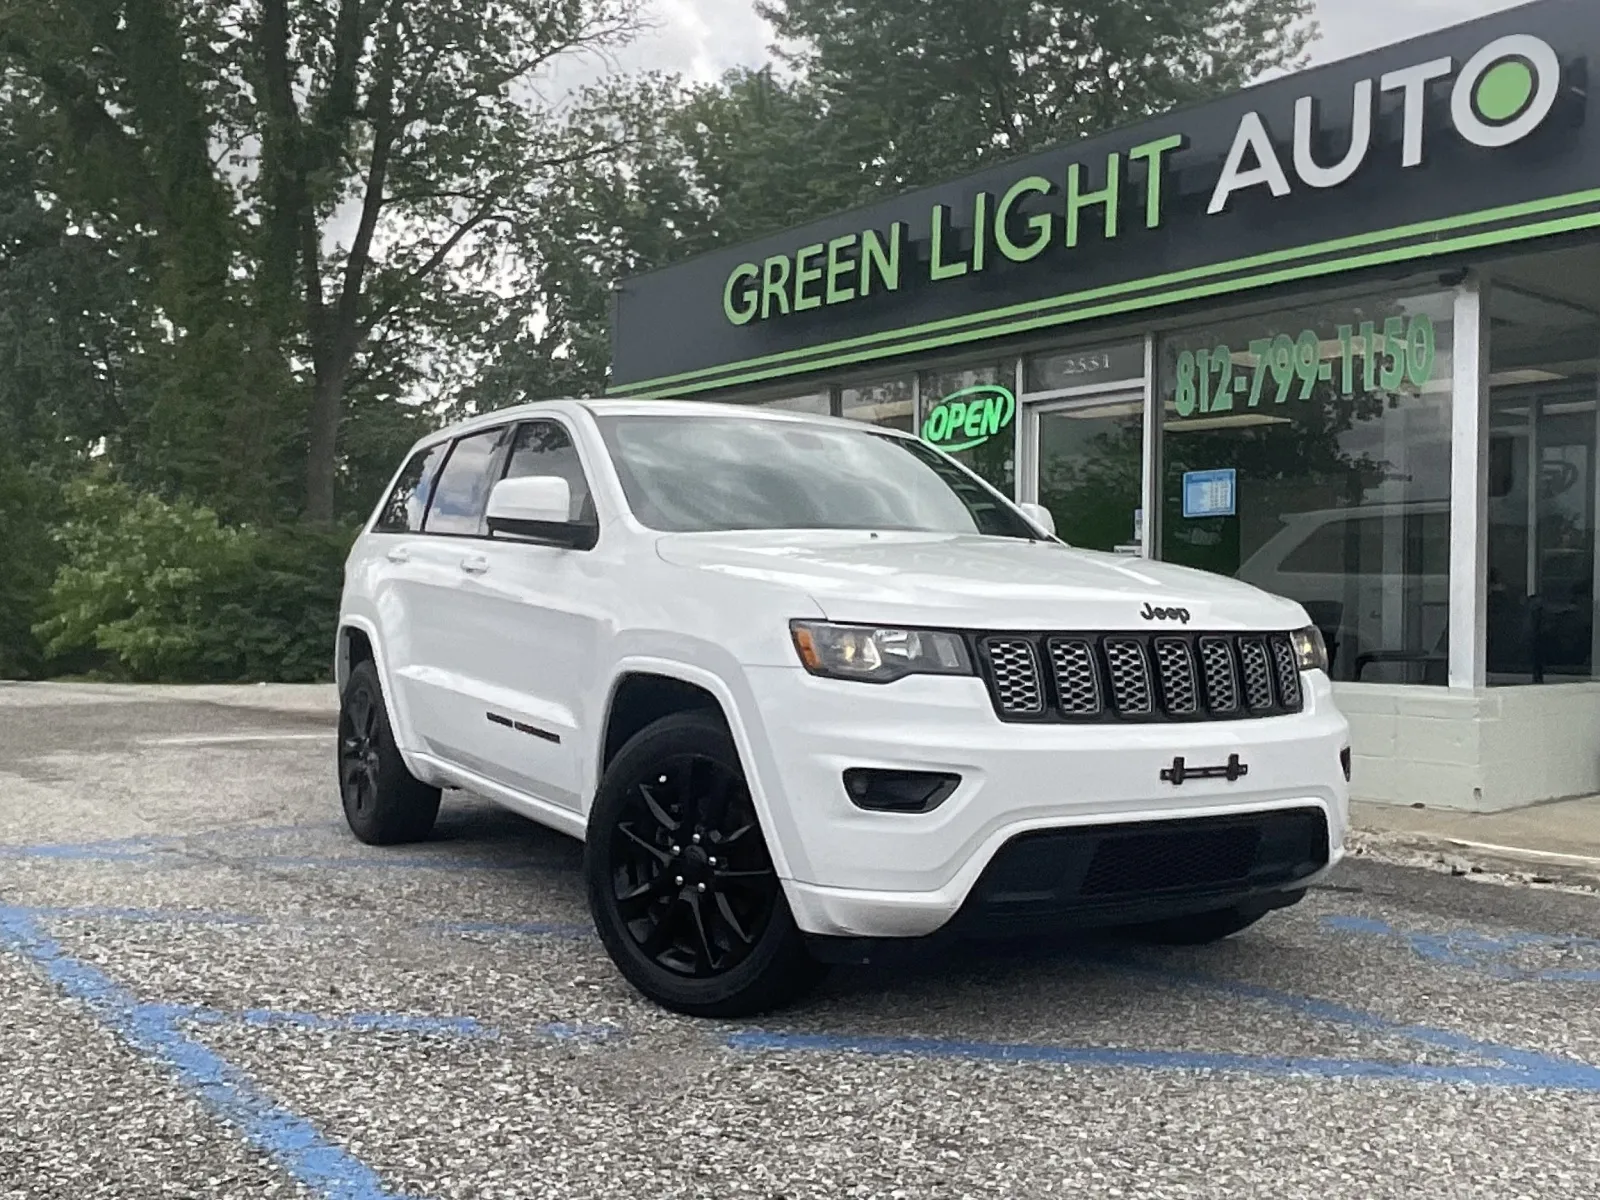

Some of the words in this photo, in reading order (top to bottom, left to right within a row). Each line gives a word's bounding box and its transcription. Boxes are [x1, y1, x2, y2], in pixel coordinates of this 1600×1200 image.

[724, 222, 902, 325] GREEN
[930, 135, 1183, 281] LIGHT
[1207, 34, 1560, 214] AUTO
[1175, 313, 1435, 416] 812-799-1150
[928, 397, 1003, 441] OPEN
[1140, 602, 1190, 624] Jeep
